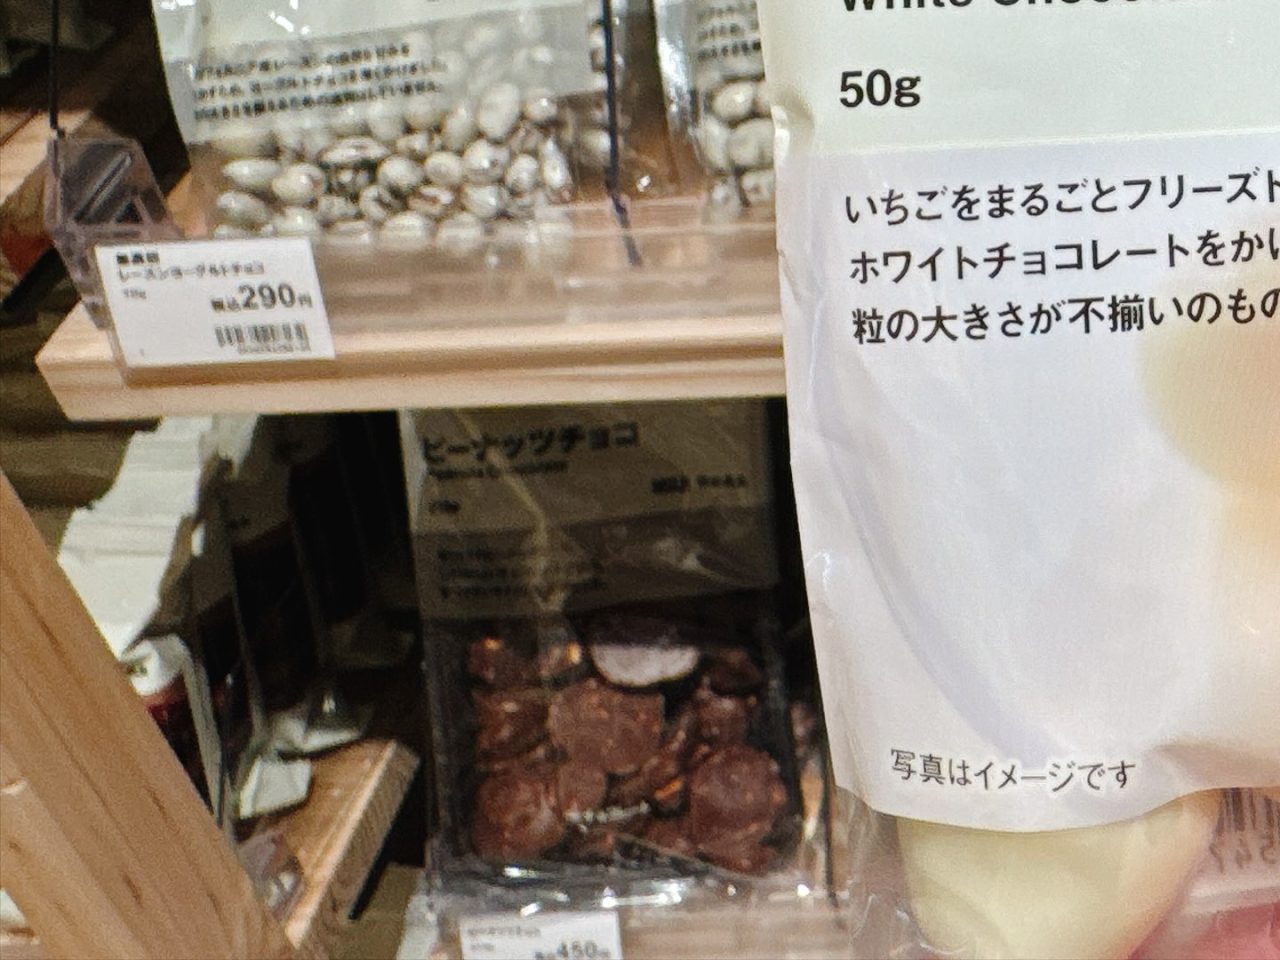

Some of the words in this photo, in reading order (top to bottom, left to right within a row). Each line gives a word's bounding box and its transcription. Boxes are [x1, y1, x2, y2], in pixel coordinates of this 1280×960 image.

[839, 68, 922, 108] 50g
[890, 748, 1137, 792] 写真はイメージです
